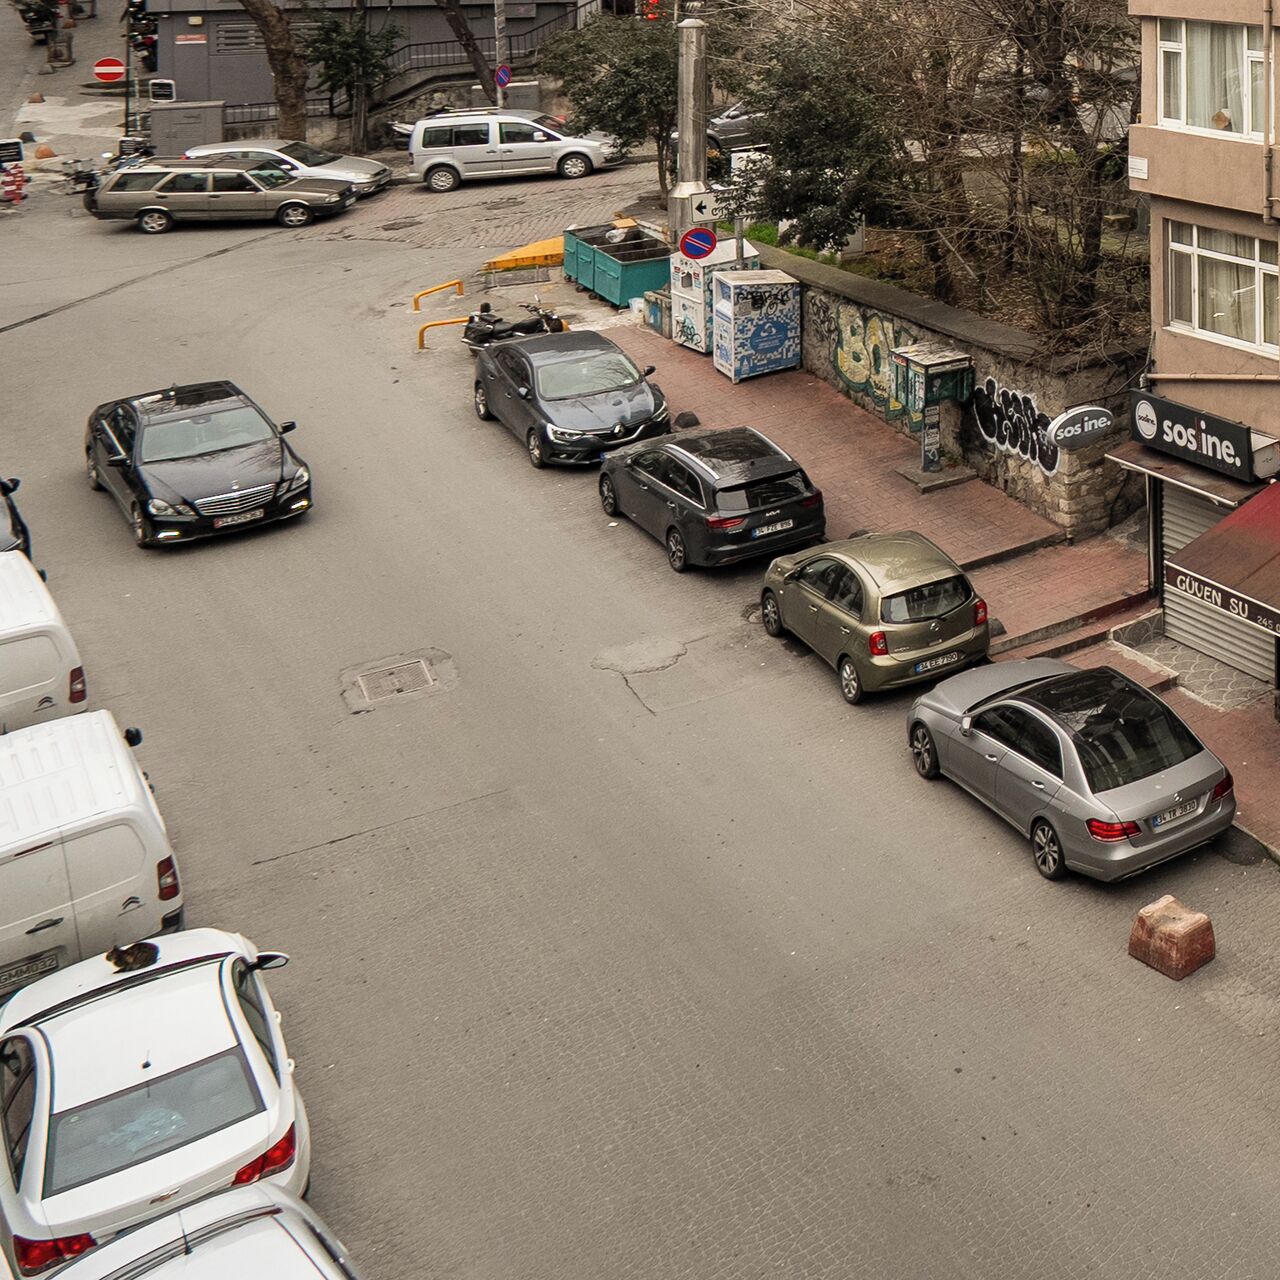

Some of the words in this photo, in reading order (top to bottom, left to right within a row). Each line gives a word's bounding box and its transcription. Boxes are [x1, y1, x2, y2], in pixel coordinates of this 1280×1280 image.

[1176, 575, 1222, 606] GÜVEN
[1229, 597, 1249, 618] SU
[1256, 615, 1273, 630] 245
